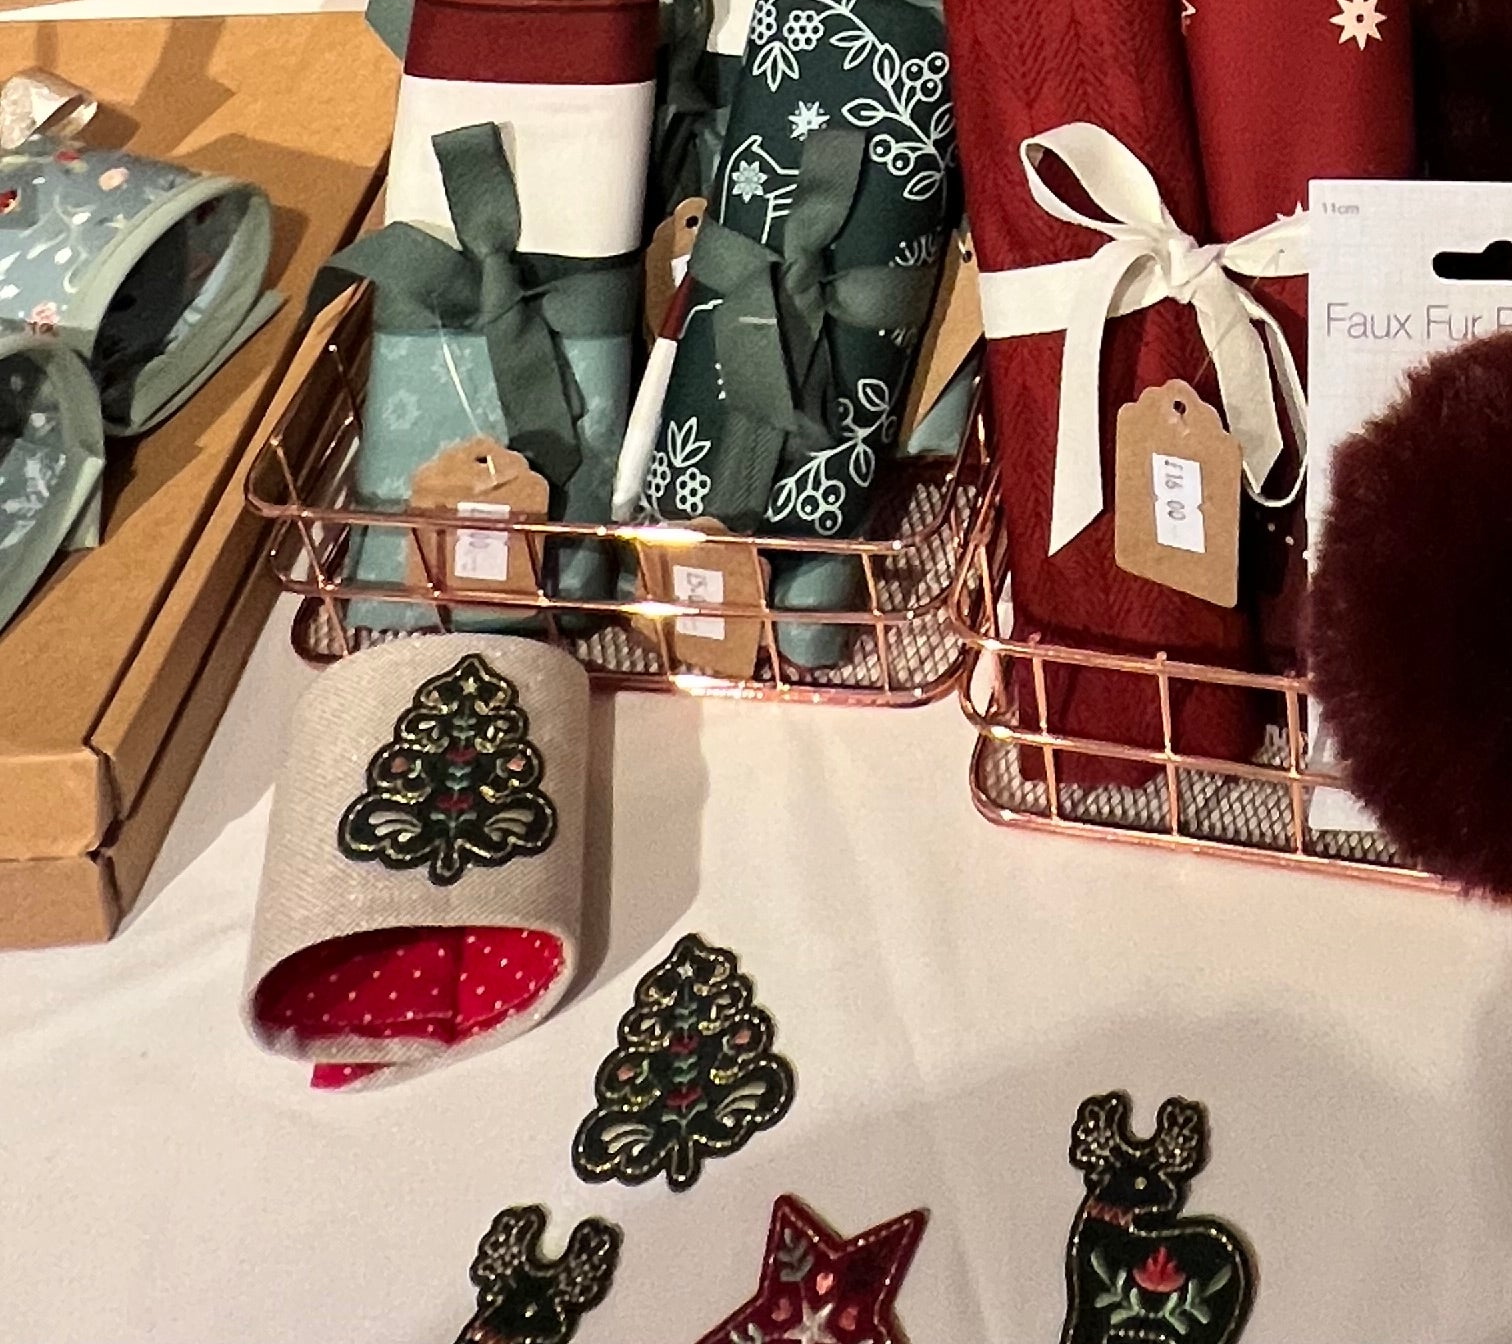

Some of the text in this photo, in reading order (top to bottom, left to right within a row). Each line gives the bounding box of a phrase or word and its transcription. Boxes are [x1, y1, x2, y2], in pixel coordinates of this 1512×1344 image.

[1321, 201, 1361, 216] 11cm
[1325, 301, 1413, 341] Faux
[1425, 304, 1483, 341] Fur
